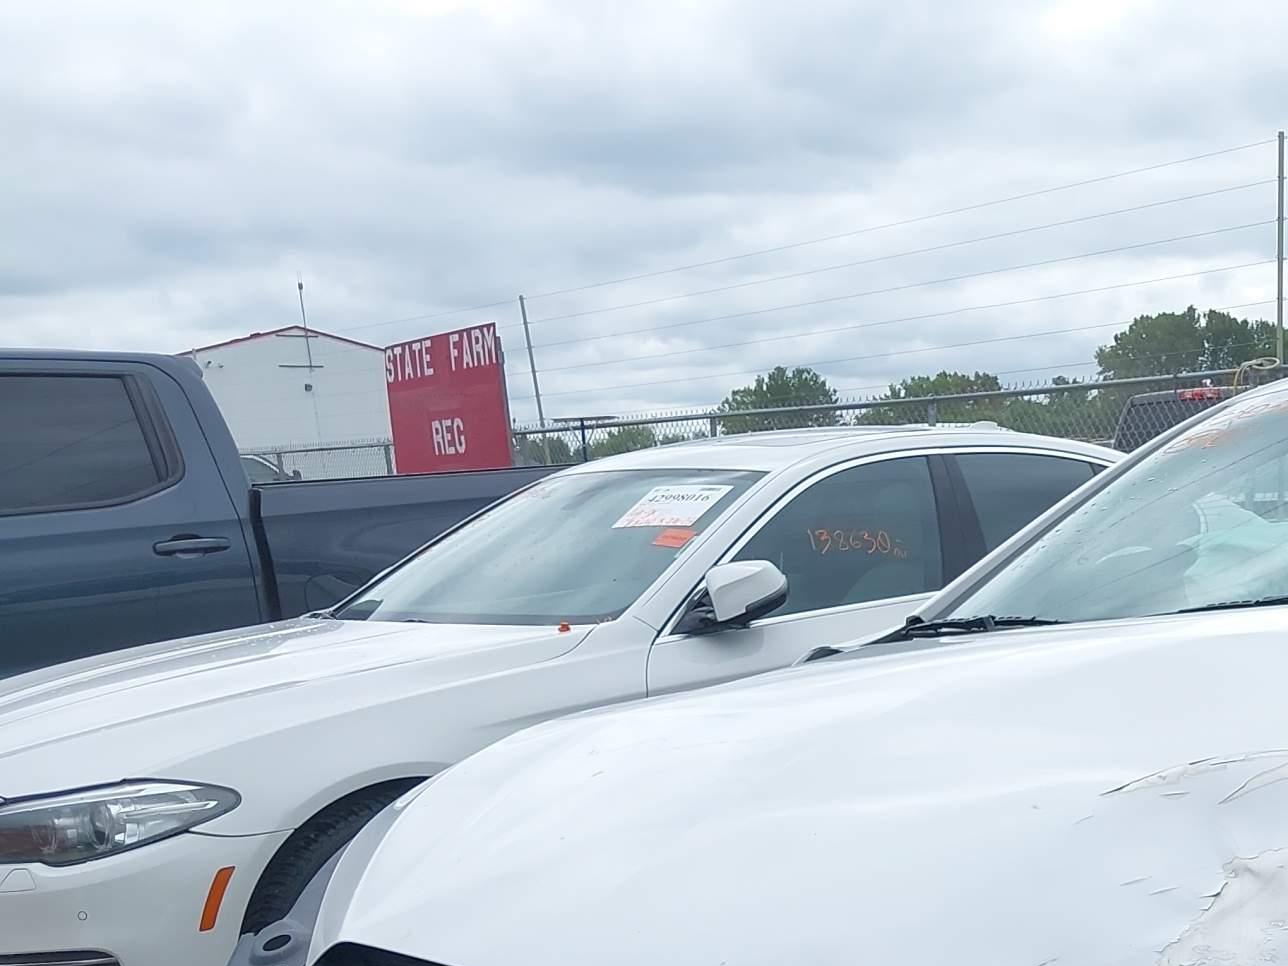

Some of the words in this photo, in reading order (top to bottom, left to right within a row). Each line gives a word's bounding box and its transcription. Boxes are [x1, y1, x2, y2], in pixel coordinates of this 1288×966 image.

[385, 340, 434, 383] STATE
[449, 326, 497, 371] FARM
[431, 417, 466, 456] REC
